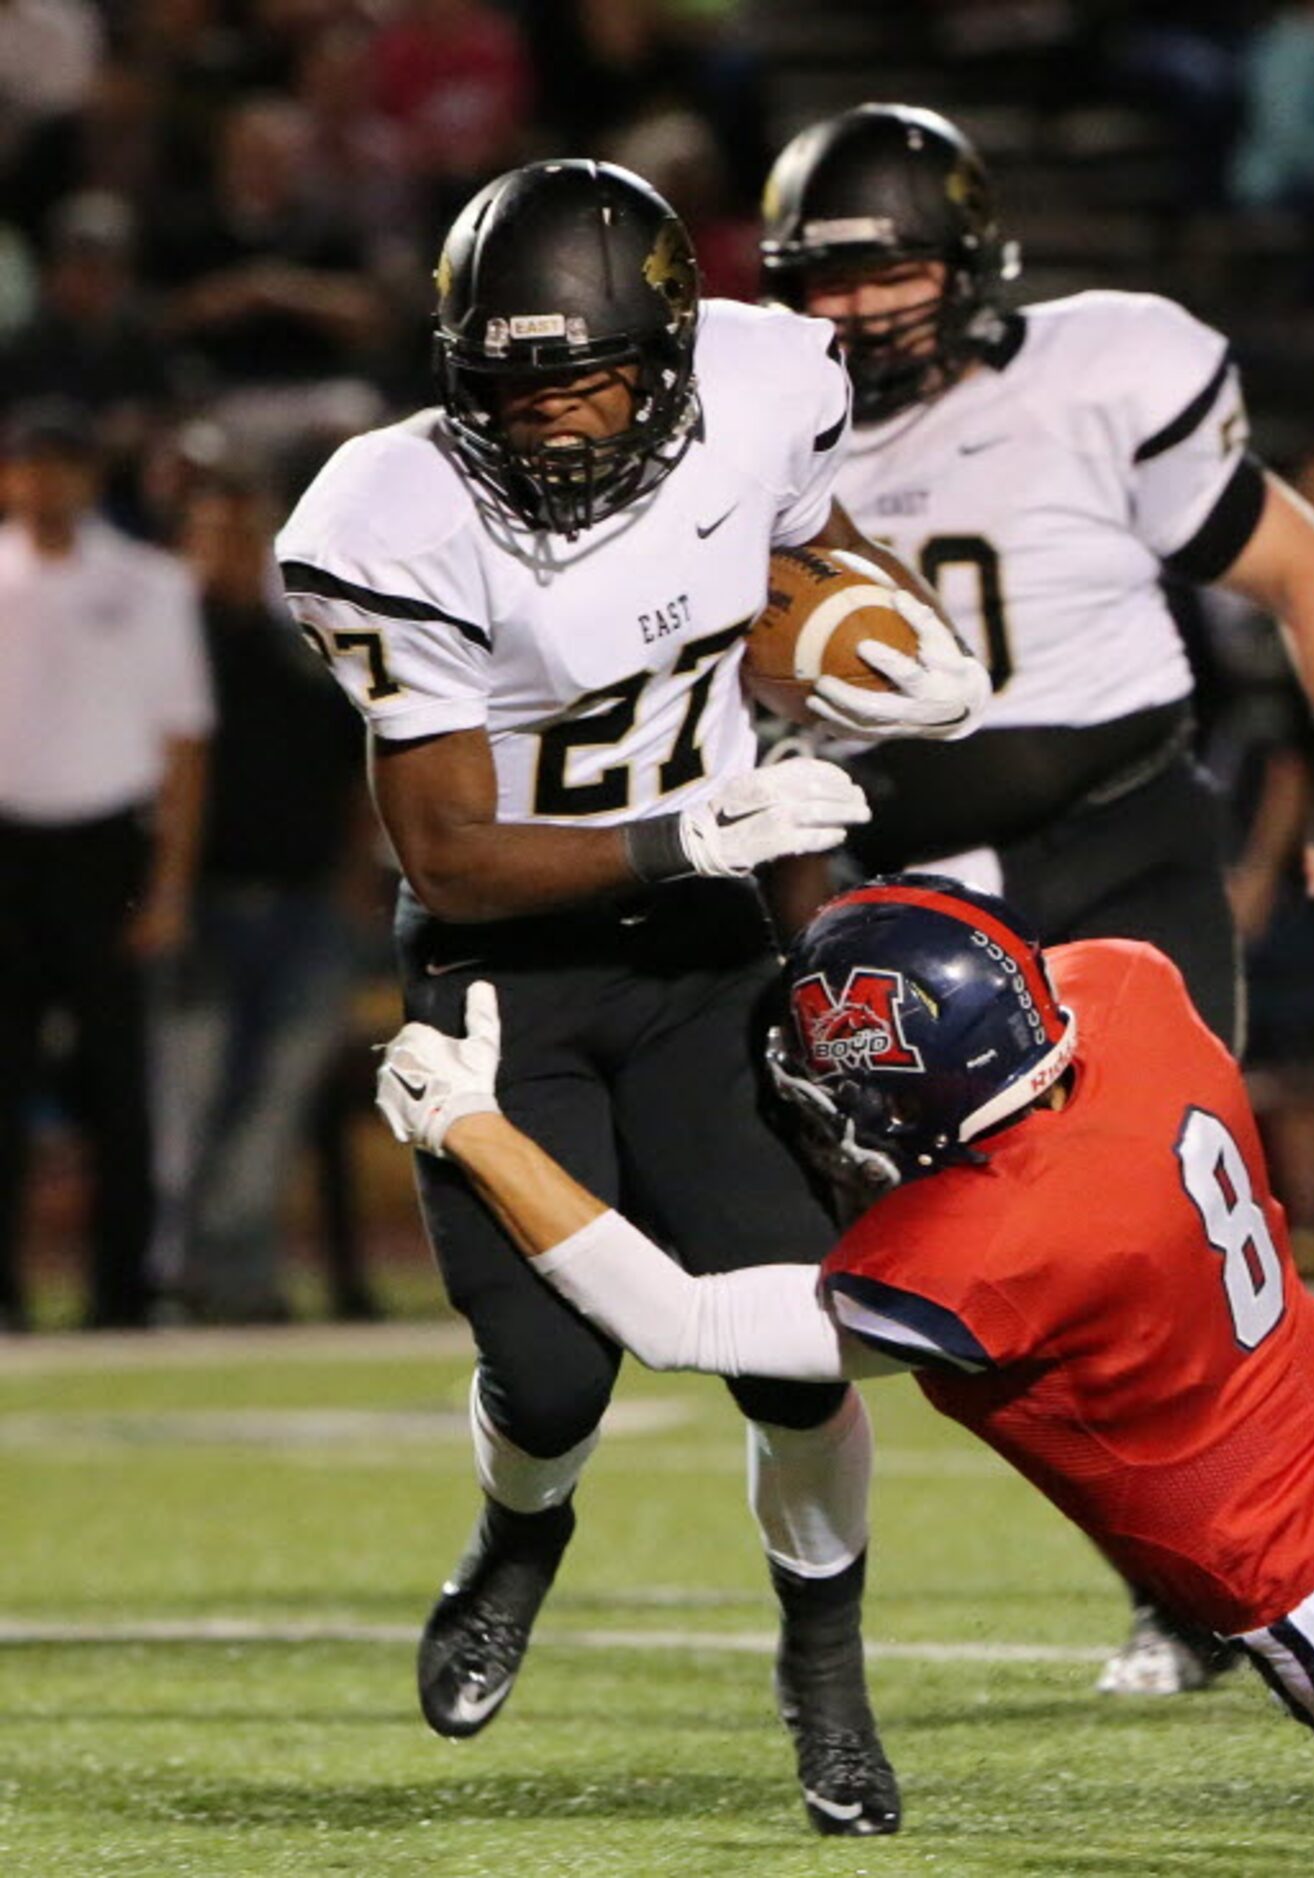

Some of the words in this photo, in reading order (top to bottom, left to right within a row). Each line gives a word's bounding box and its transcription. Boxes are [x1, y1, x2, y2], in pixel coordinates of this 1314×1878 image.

[514, 319, 561, 336] EAST
[637, 594, 693, 644] EAST
[529, 616, 757, 818] 27
[814, 1033, 893, 1070] BOYD
[1173, 1105, 1287, 1353] 8
